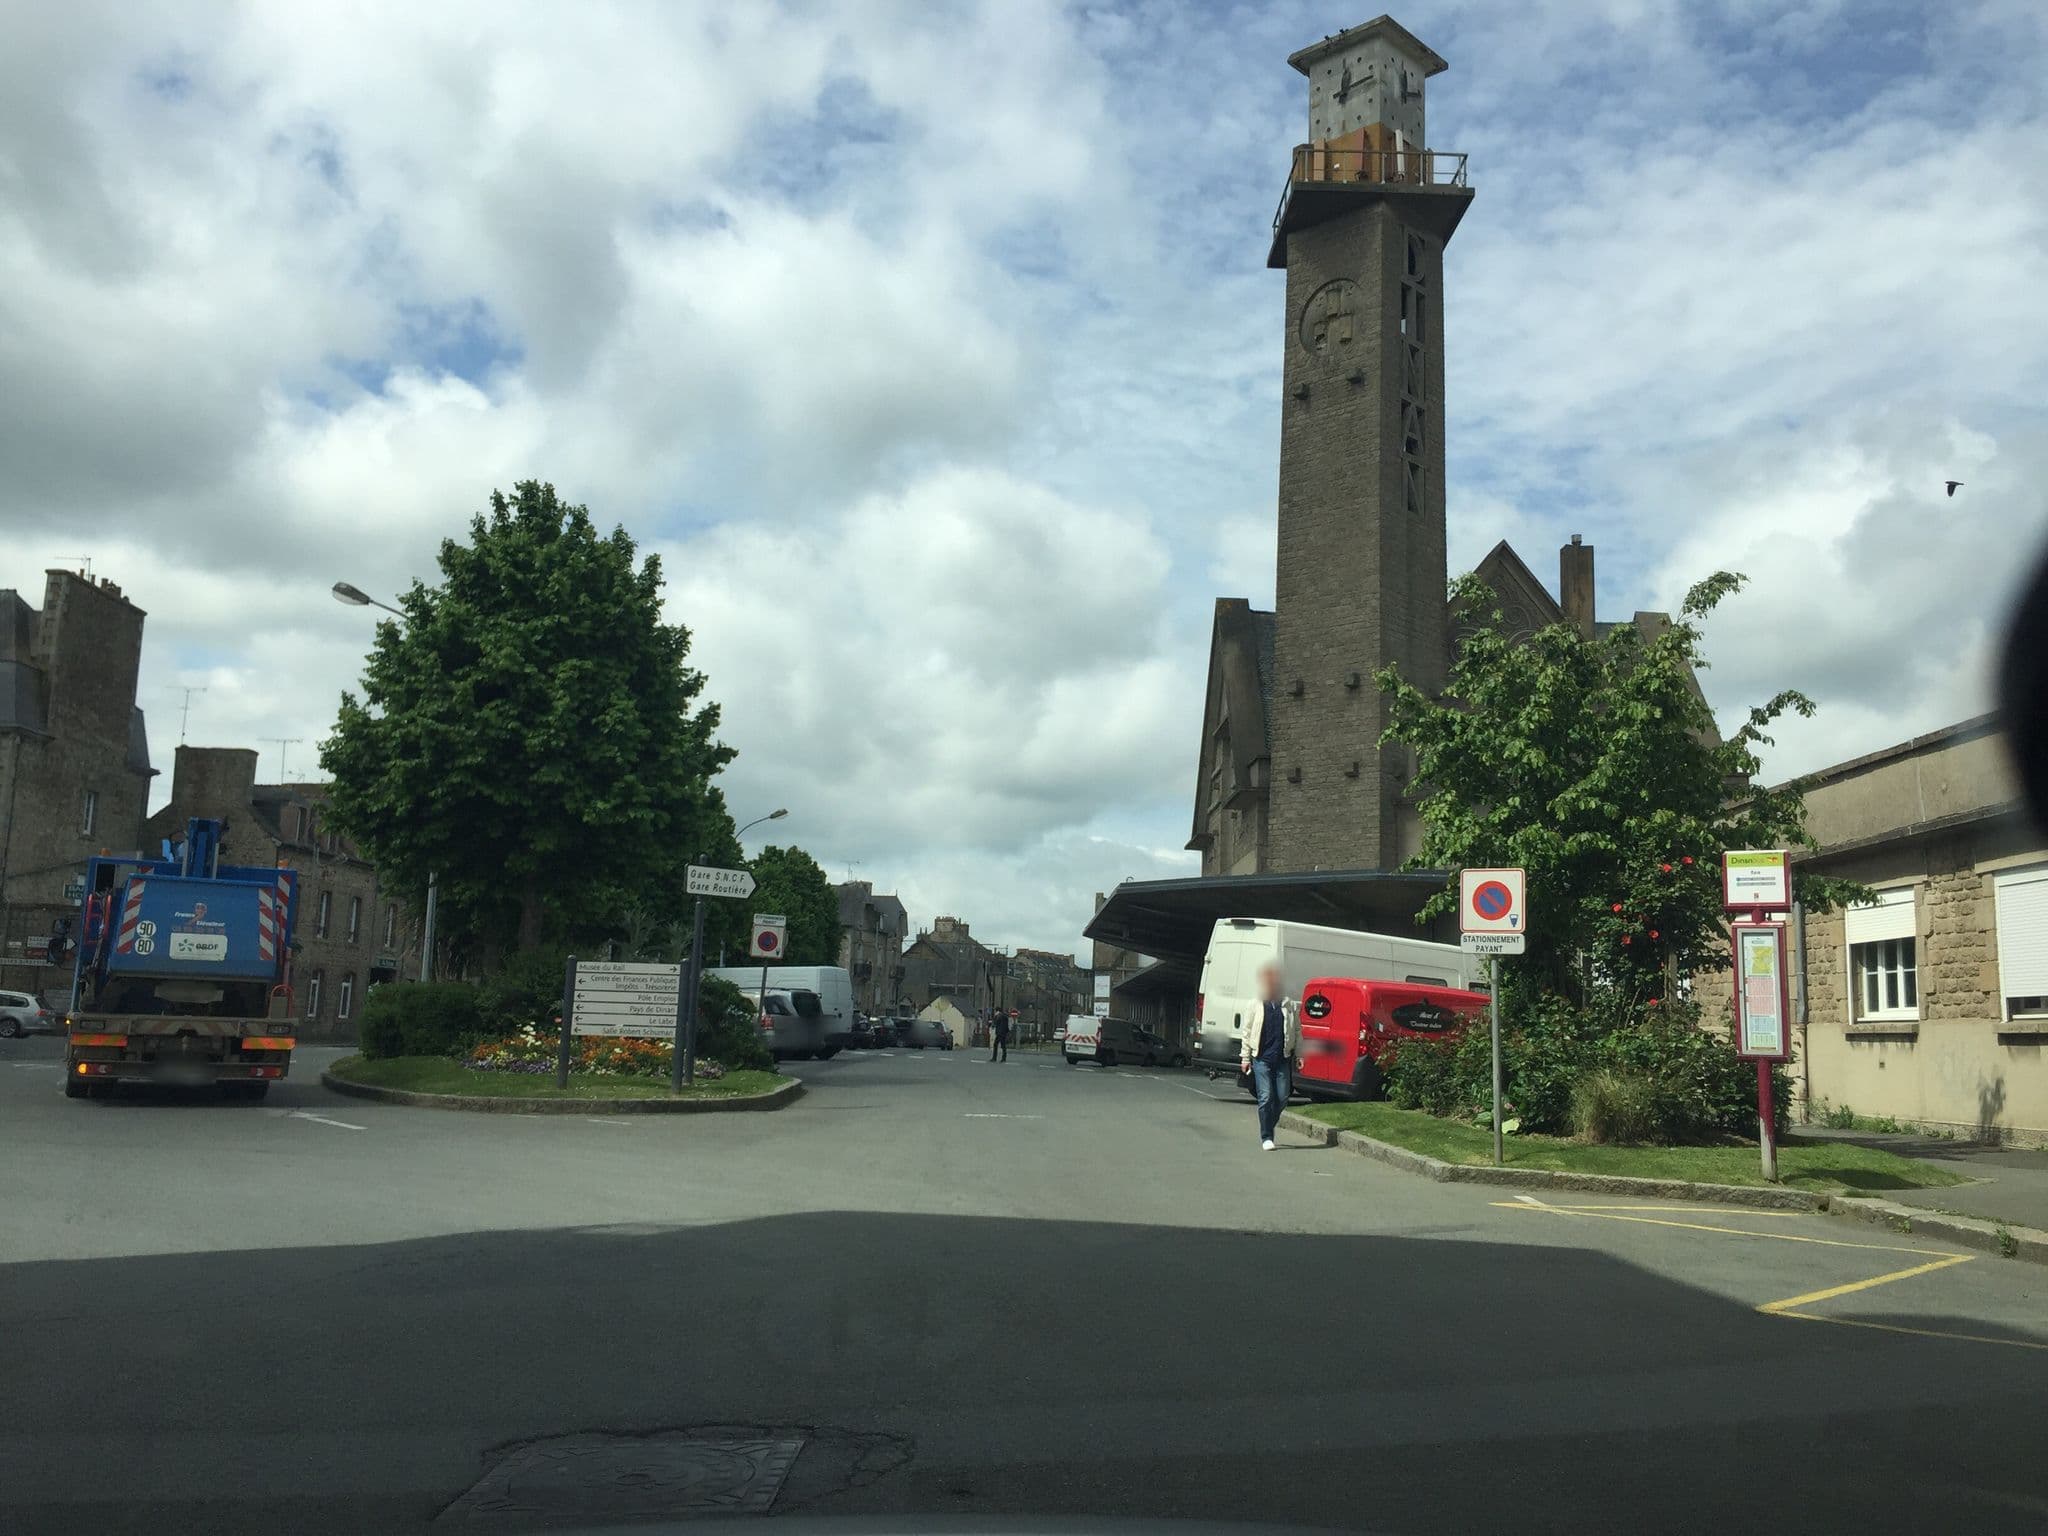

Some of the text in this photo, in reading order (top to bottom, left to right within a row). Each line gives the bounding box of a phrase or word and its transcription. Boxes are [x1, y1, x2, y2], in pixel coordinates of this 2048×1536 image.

[690, 869, 711, 880] Gare
[690, 881, 748, 895] Gare Routière
[139, 922, 154, 936] 90
[1463, 935, 1520, 944] STATIONNEMENT
[137, 939, 152, 953] 80
[1475, 945, 1503, 953] PAYANT
[579, 963, 601, 971] Musée
[602, 963, 611, 971] du
[649, 977, 677, 985] Publiques
[653, 995, 676, 1003] Emploi
[629, 1006, 643, 1014] Pays
[643, 1028, 674, 1036] Schuman
